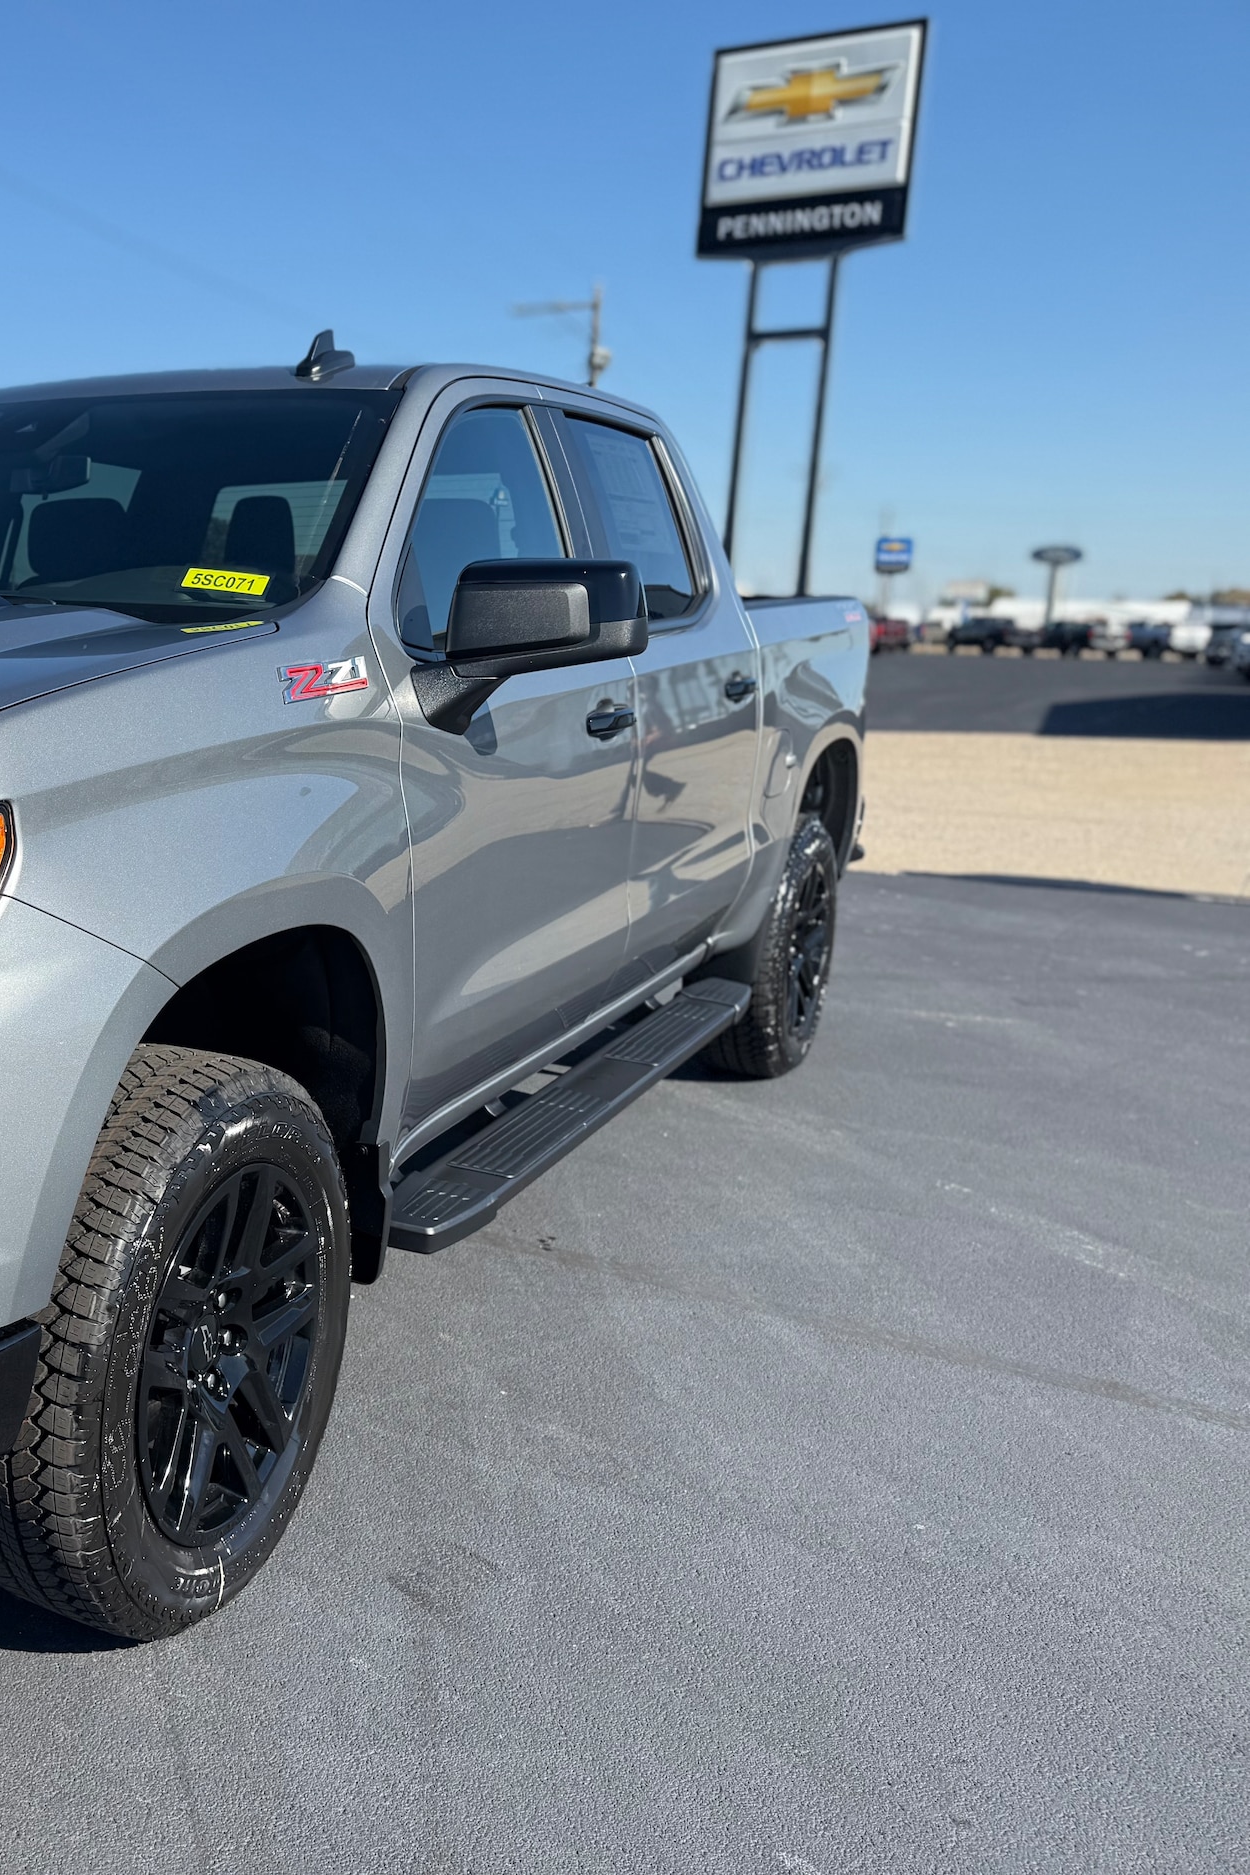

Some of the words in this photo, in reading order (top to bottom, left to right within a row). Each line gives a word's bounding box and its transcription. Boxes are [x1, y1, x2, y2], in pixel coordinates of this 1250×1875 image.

[717, 139, 893, 182] CHEVROLET
[717, 201, 883, 240] PENNINGTON
[191, 573, 255, 591] 5SC071
[276, 655, 369, 704] Z71
